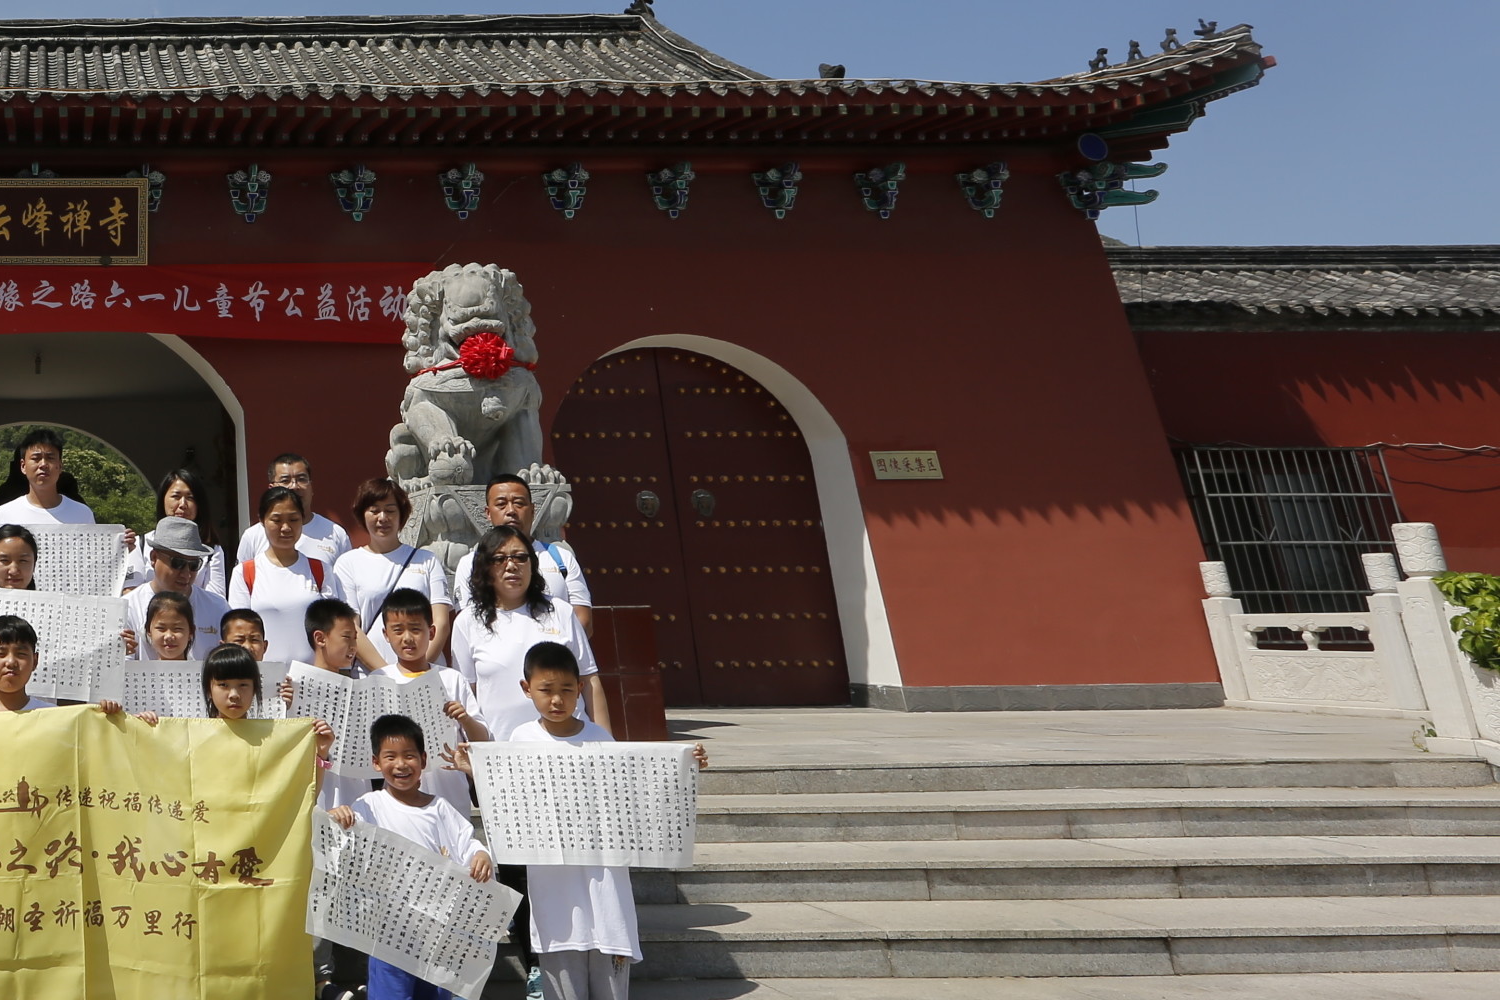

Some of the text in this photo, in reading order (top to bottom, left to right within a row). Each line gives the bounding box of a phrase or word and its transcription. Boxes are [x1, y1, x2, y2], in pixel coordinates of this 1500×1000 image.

[55, 785, 210, 824] 传递祝福传递爱
